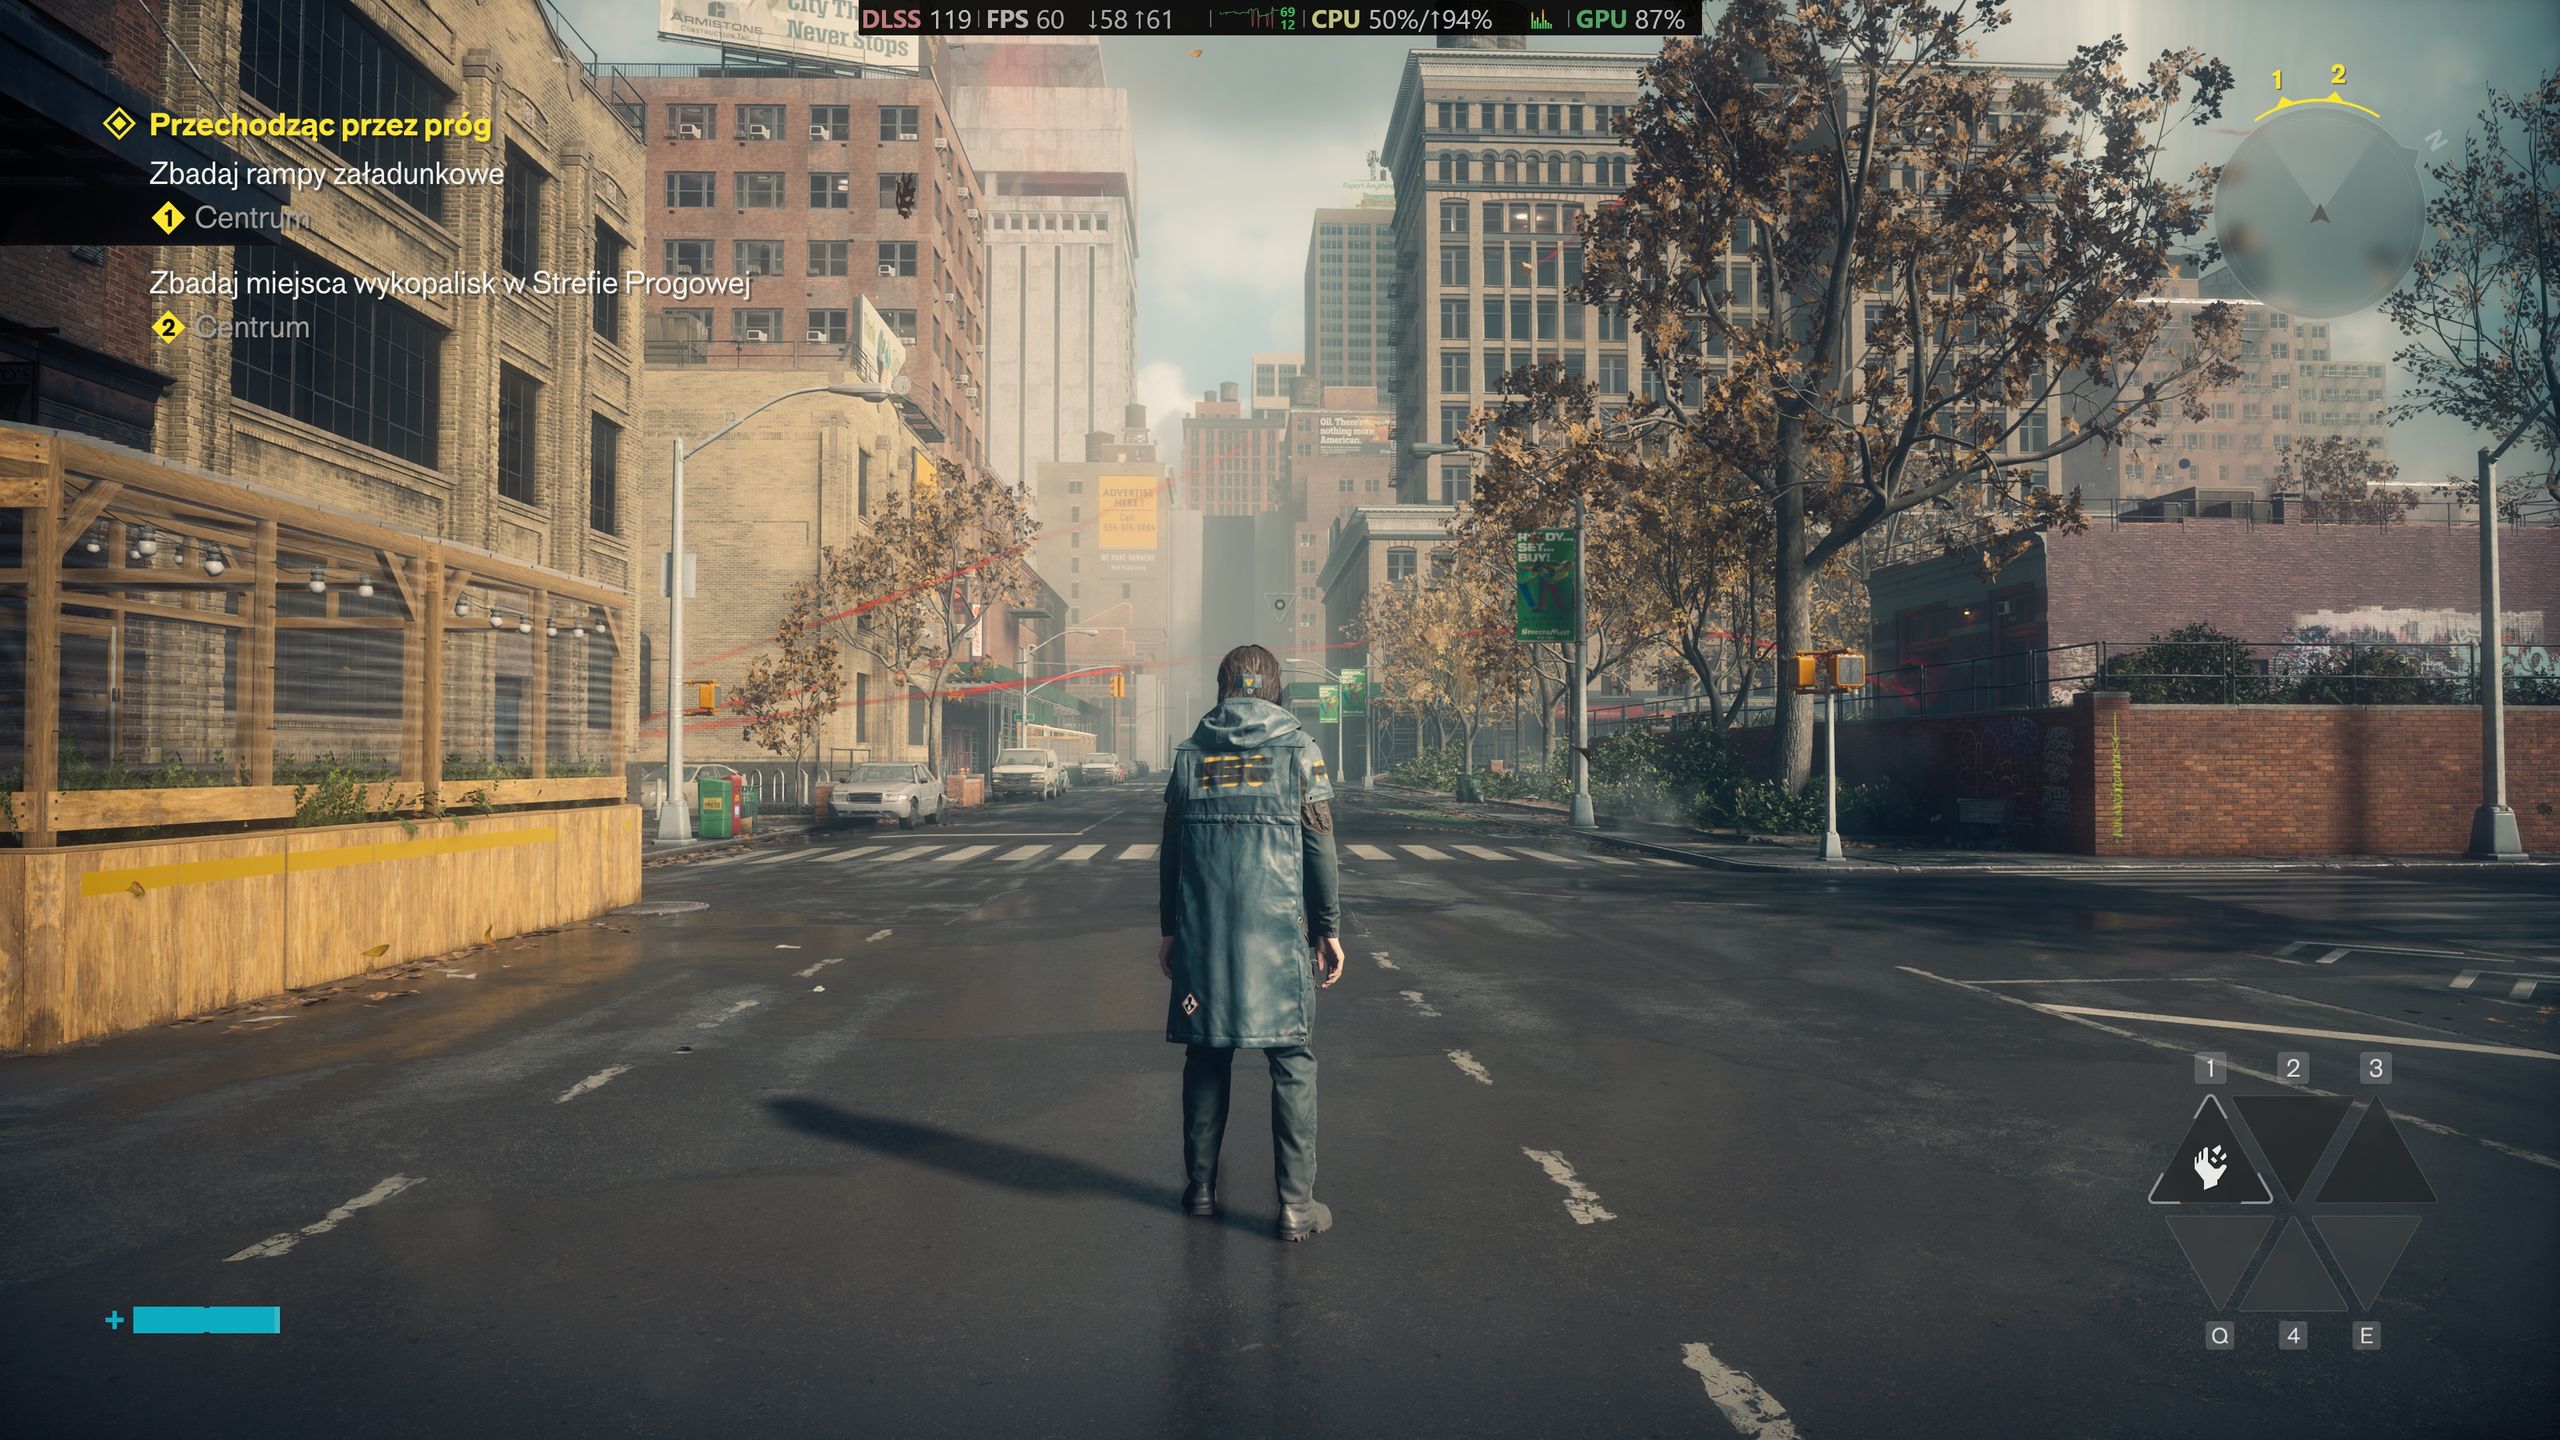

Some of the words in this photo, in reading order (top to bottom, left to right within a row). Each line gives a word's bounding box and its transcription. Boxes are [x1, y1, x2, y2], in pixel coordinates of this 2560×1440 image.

[670, 12, 763, 35] ARMISTONE
[787, 19, 850, 47] Never
[853, 29, 909, 58] Stops
[1320, 417, 1334, 426] Oil.
[1320, 427, 1352, 437] nothing
[1320, 436, 1362, 444] American.
[1103, 488, 1153, 497] ADVERTISE
[1517, 542, 1555, 552] SET...
[1517, 552, 1551, 562] BUY!
